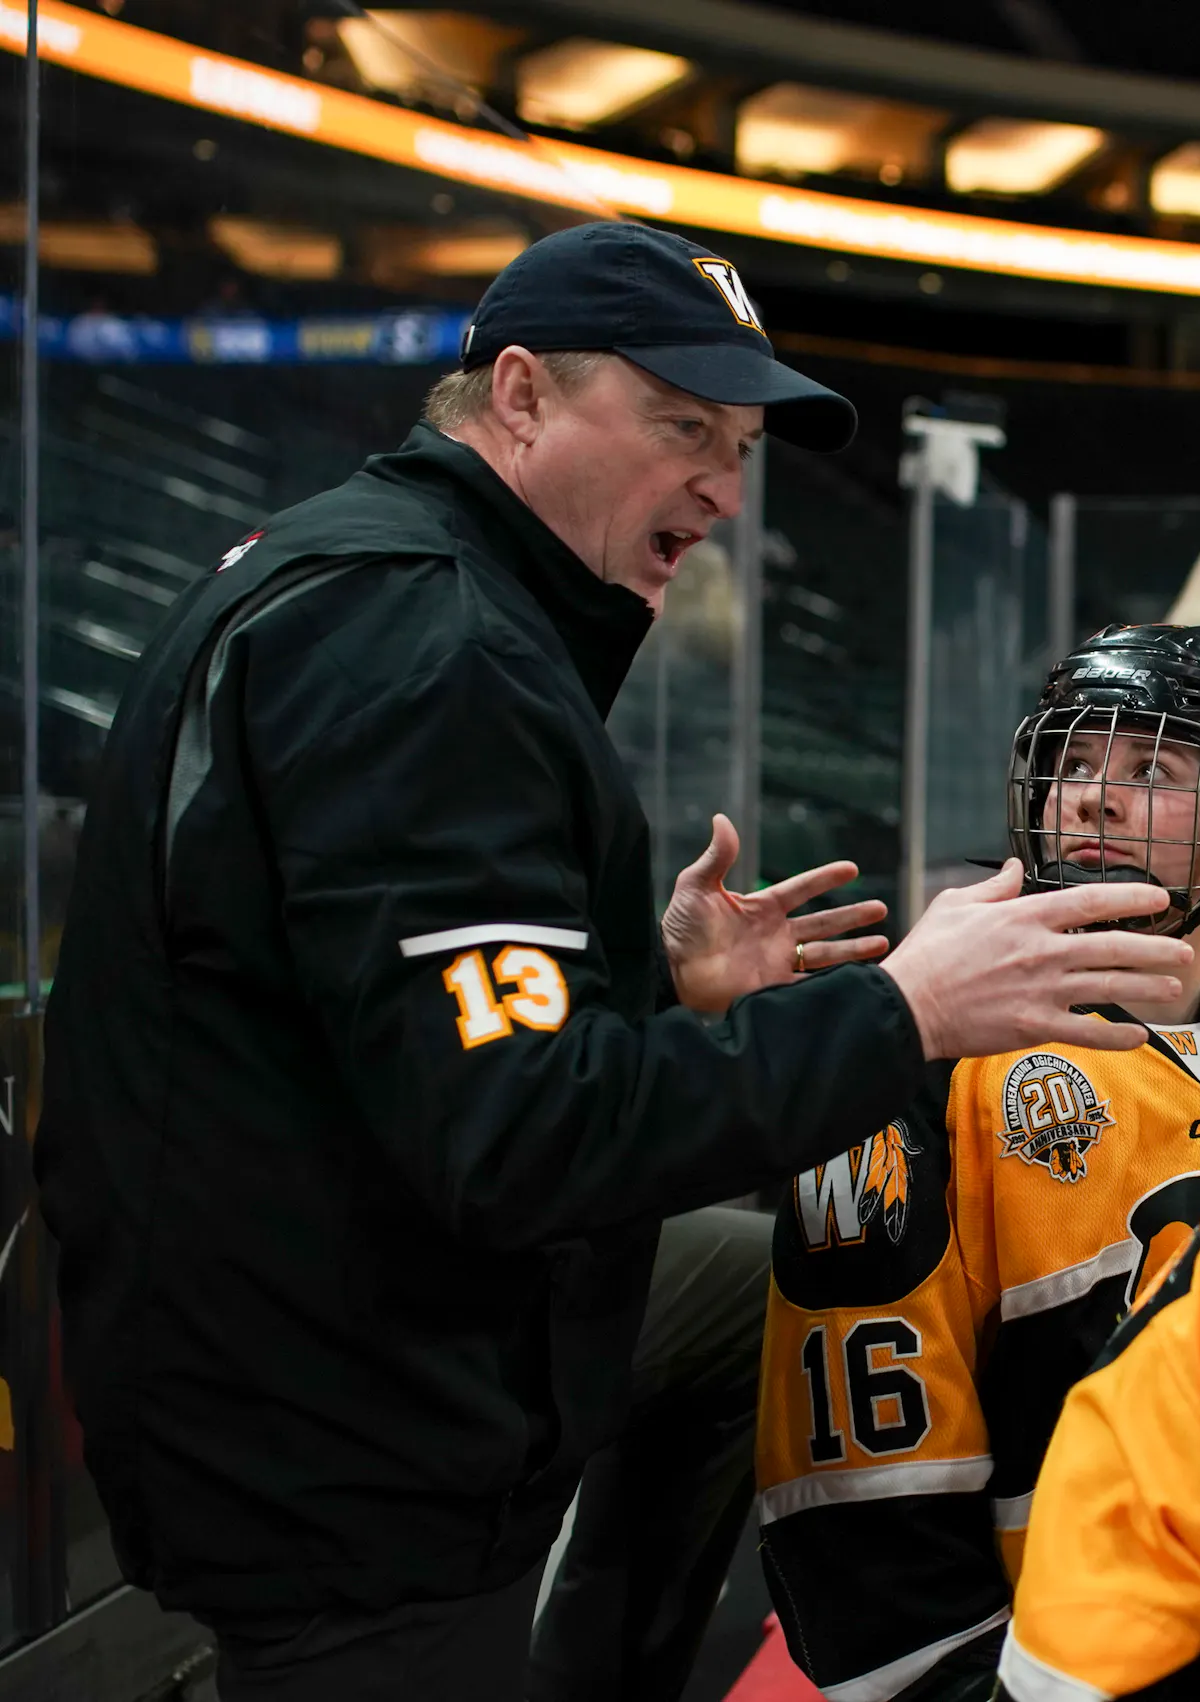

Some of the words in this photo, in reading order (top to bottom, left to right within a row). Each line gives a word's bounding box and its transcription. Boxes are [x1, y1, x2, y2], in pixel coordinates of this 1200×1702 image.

[1071, 667, 1152, 681] BAUER
[442, 945, 569, 1050] 13
[1158, 1030, 1198, 1056] W
[1007, 1060, 1033, 1128] KAABEKANONG
[1031, 1055, 1095, 1107] OGICHIDAAKWEG
[1021, 1073, 1078, 1133] 20
[1030, 1123, 1092, 1155] ANNIVERSARY
[794, 1133, 875, 1253] W
[801, 1315, 932, 1466] 16
